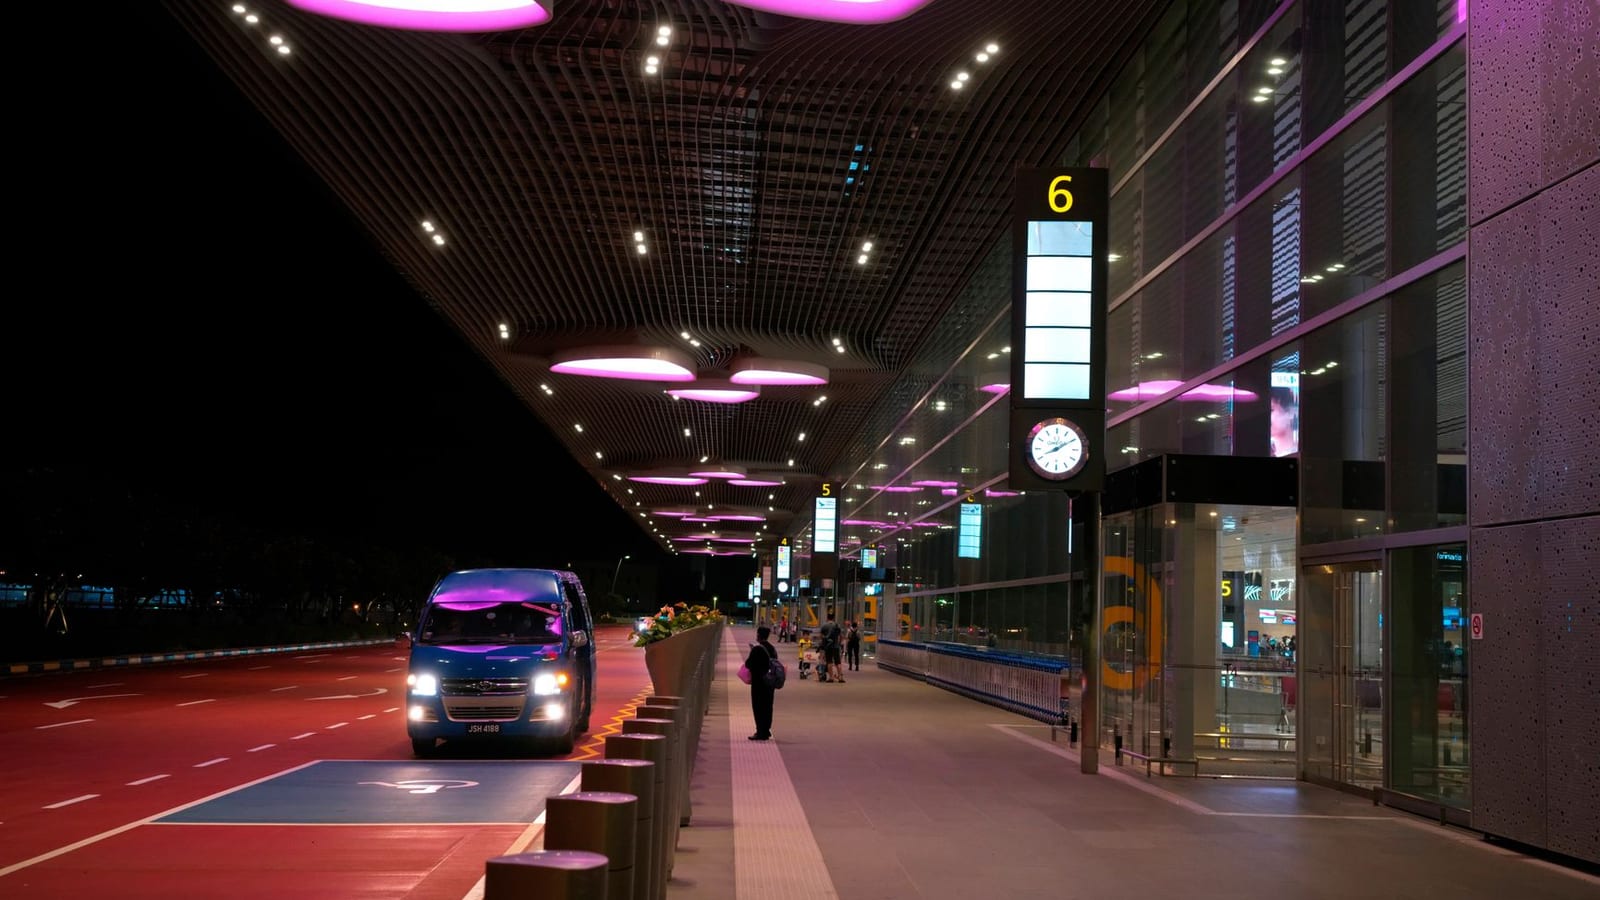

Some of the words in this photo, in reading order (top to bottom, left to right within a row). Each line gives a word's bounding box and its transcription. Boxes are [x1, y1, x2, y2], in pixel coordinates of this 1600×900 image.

[1048, 175, 1073, 213] 6
[822, 483, 831, 496] 5
[781, 537, 788, 545] 4
[1221, 580, 1231, 597] 5
[468, 724, 483, 733] JSH
